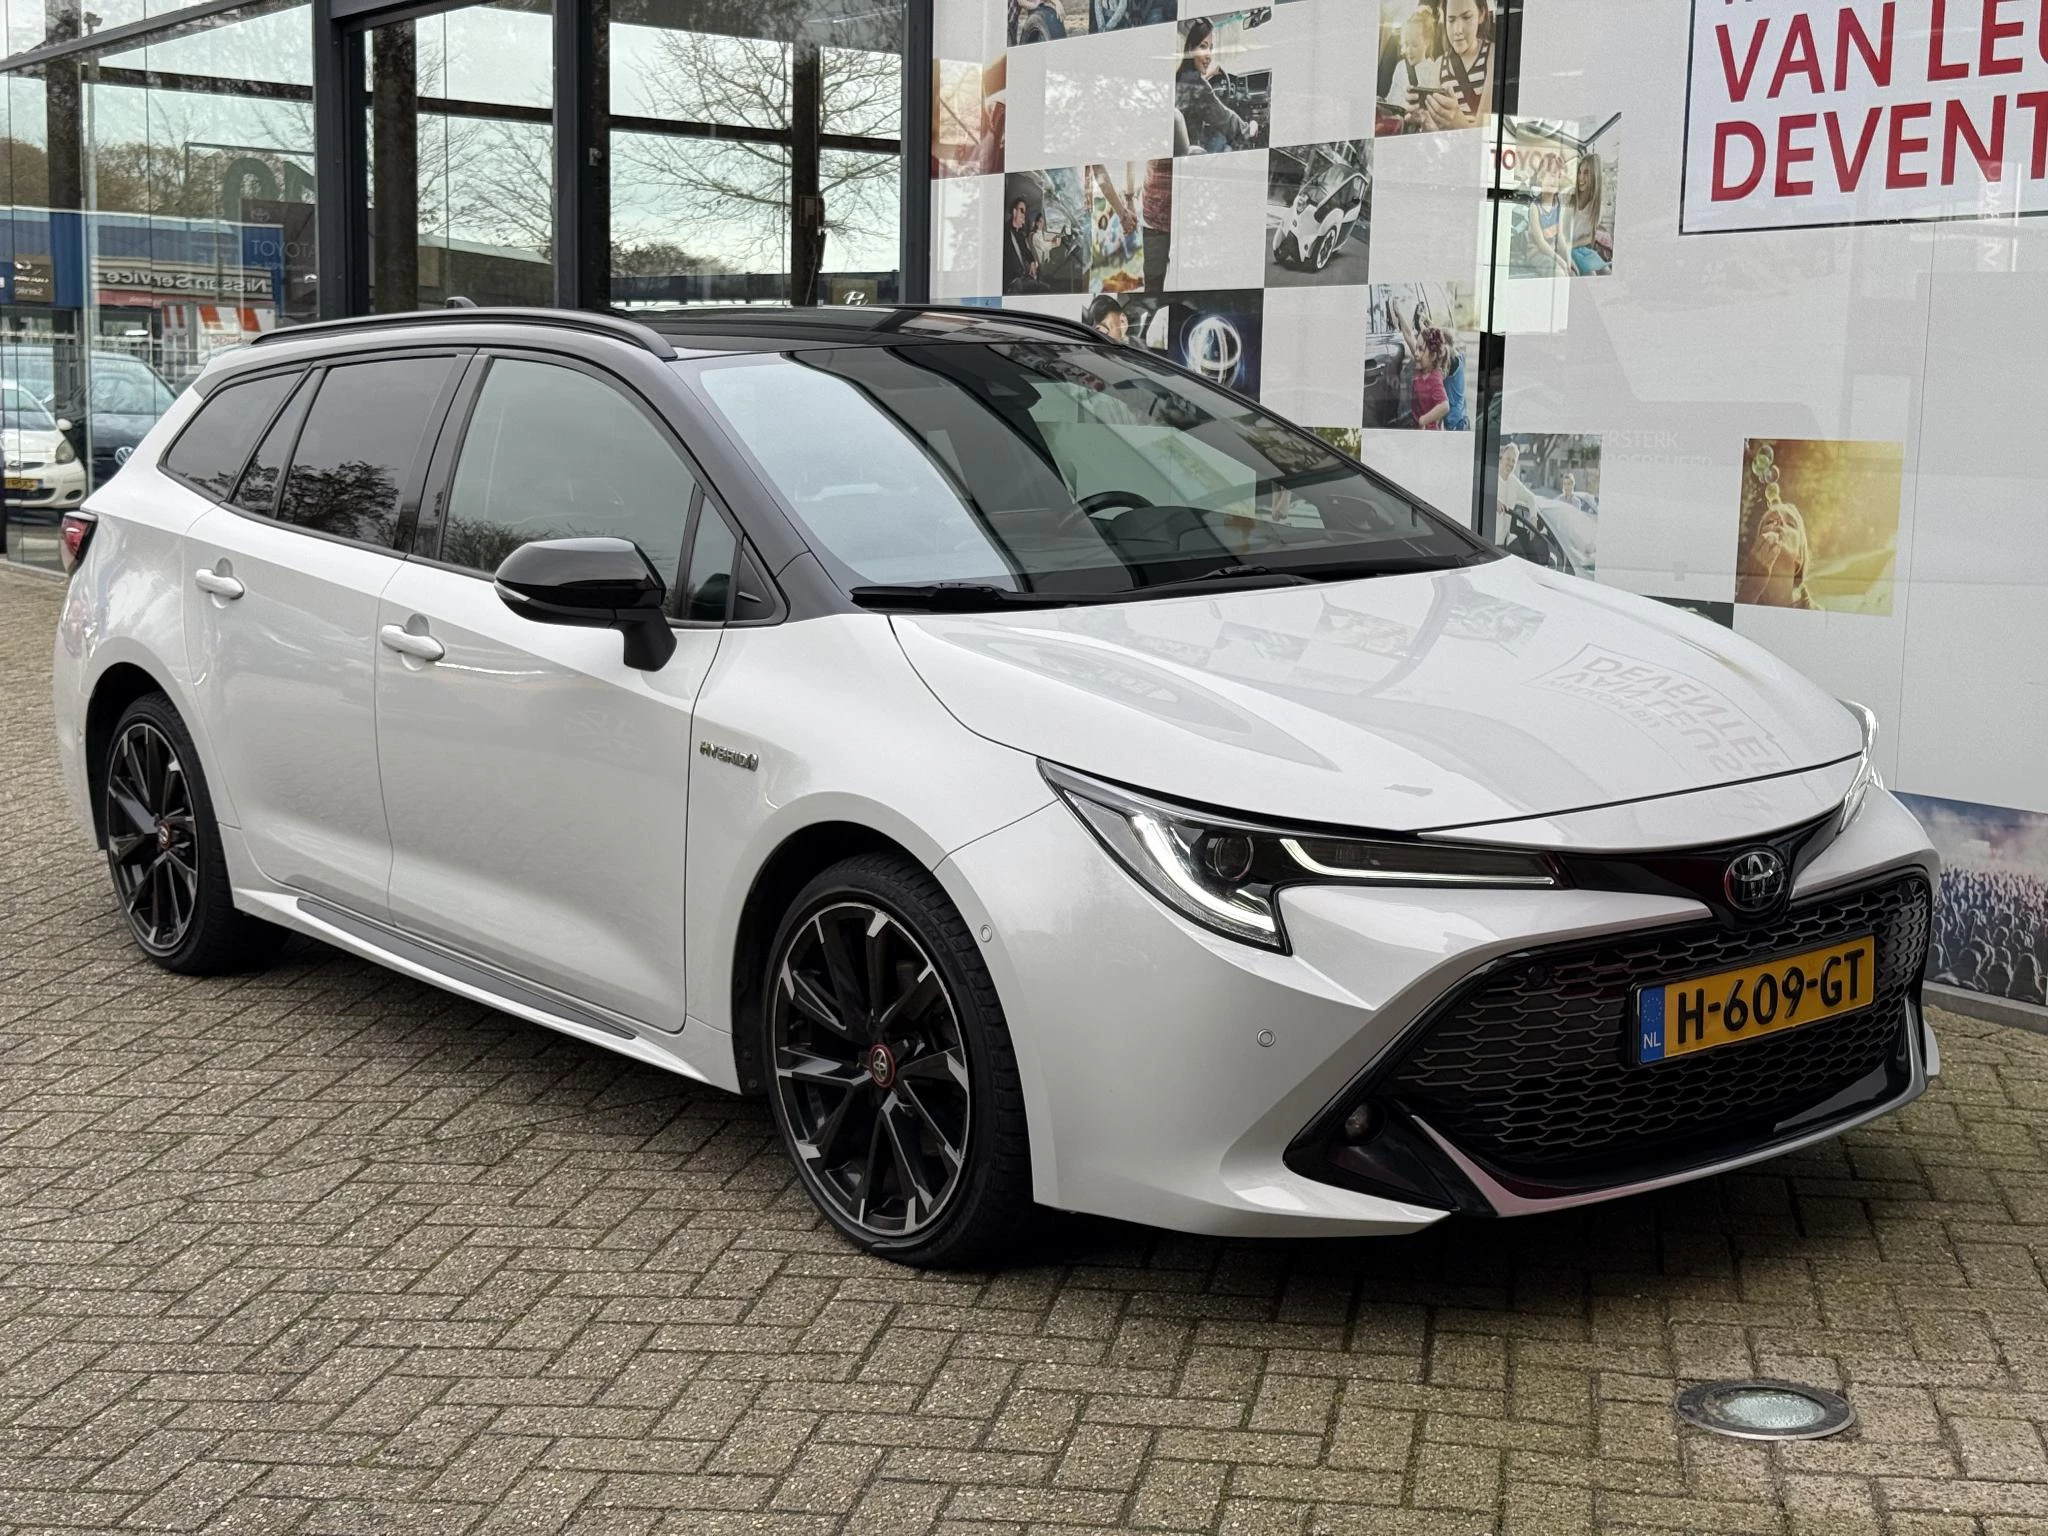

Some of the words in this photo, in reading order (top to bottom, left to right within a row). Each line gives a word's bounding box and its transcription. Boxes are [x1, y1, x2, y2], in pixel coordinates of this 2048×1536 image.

[1715, 2, 1896, 103] VAN
[1927, 0, 2048, 83] LE
[1711, 91, 2048, 203] DEVENT
[699, 740, 757, 771] HYBRID
[1643, 1031, 1661, 1049] NL
[1678, 948, 1865, 1045] H-609-GT
